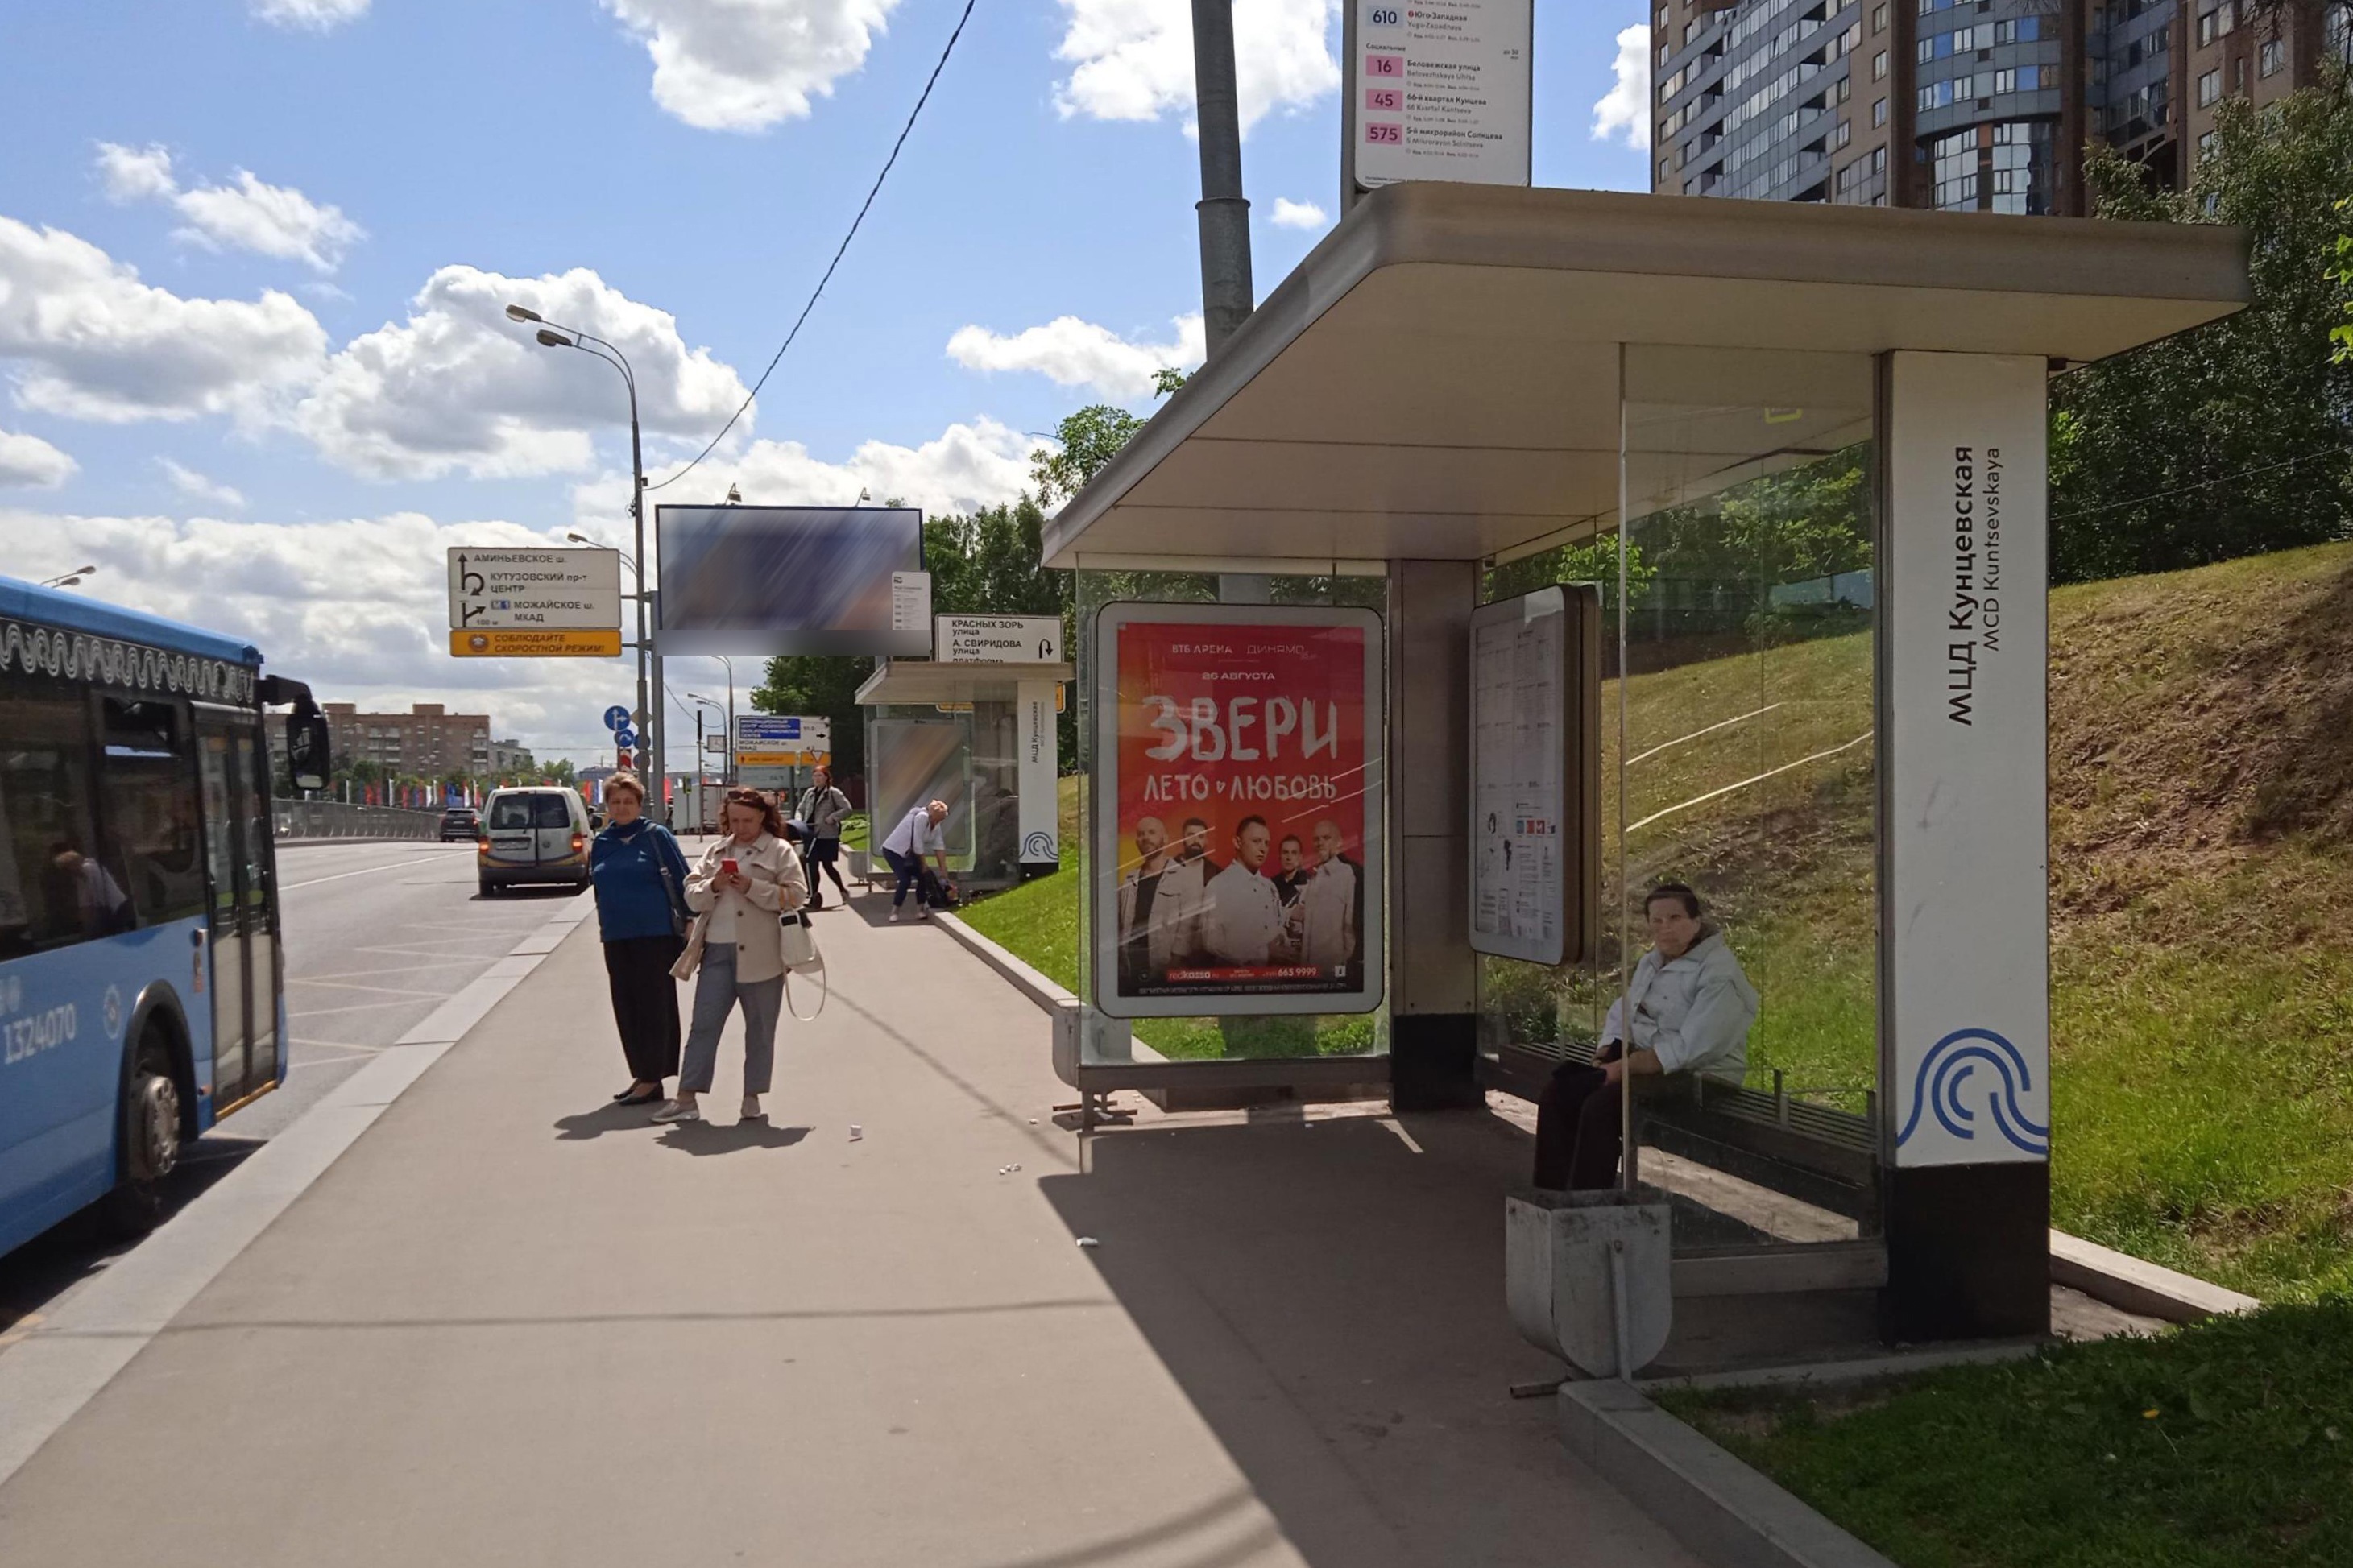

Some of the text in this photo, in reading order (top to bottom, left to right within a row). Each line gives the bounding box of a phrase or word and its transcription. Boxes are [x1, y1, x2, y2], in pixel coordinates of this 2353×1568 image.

[1373, 10, 1398, 25] 610
[1377, 60, 1393, 73] 16
[1407, 60, 1481, 72] Беловежская улица
[1374, 93, 1394, 107] 45
[1406, 93, 1487, 107] 66-й квартал Кунцева
[1369, 127, 1398, 142] 575
[1467, 130, 1503, 141] Солнцева
[1982, 447, 2004, 652] MCD Kuntsevskaya
[474, 554, 553, 563] АМИНЬЕВСКОЕ
[490, 572, 564, 581] КУТУЗОВСКИЙ
[491, 585, 525, 594] ЦЕНТР
[1949, 445, 1980, 726] МЦД Кунцевская
[514, 599, 581, 610] МОЖАЙСКОЕ
[514, 613, 544, 623] МКАД
[952, 620, 1024, 629] КРАСНЫХ ЗОРЬ
[952, 628, 980, 636] улица
[494, 634, 565, 643] СОБЛЮДАЙТЕ
[964, 639, 1022, 648] СВИРИДОВА
[494, 643, 564, 653] СКОРОСТНОЙ
[952, 647, 980, 656] улица
[1172, 644, 1191, 655] ВТБ
[1202, 672, 1275, 681] 26 АВГУСТА
[1141, 695, 1338, 761] ЗВЕРИ
[1144, 774, 1337, 802] ЛЕТО ЛЮБОВЬ
[1278, 967, 1294, 977] 665
[1295, 966, 1317, 977] 9999
